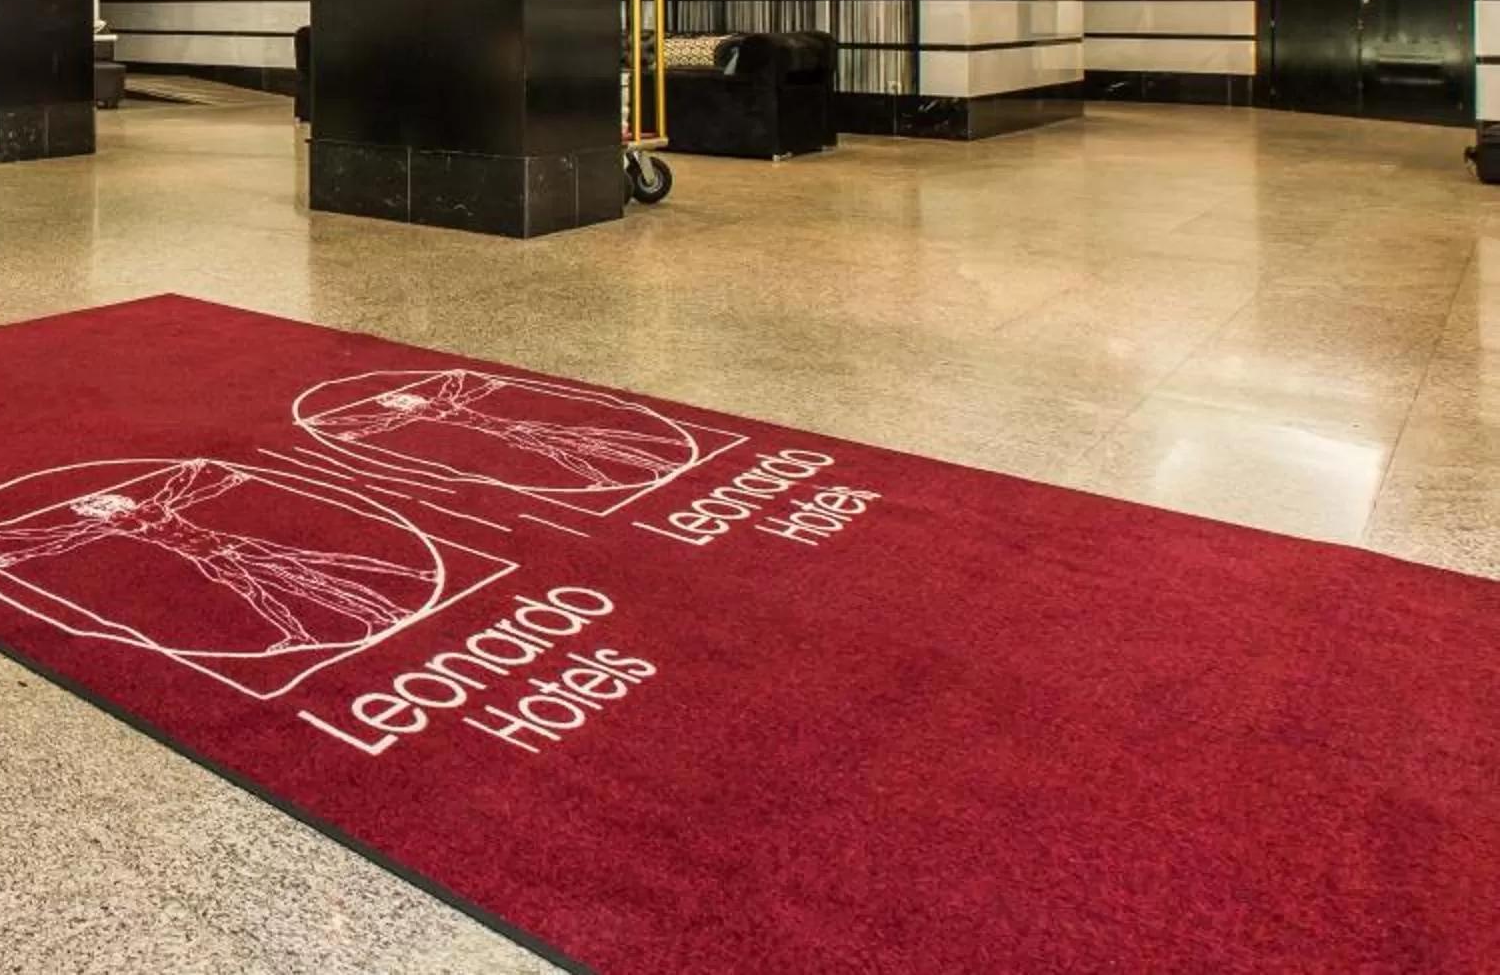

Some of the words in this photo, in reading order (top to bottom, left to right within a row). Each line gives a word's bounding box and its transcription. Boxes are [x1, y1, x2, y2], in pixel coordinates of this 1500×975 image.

[631, 449, 835, 546] Leonardo
[297, 586, 614, 756] Leonardo
[463, 648, 657, 754] Hotels
